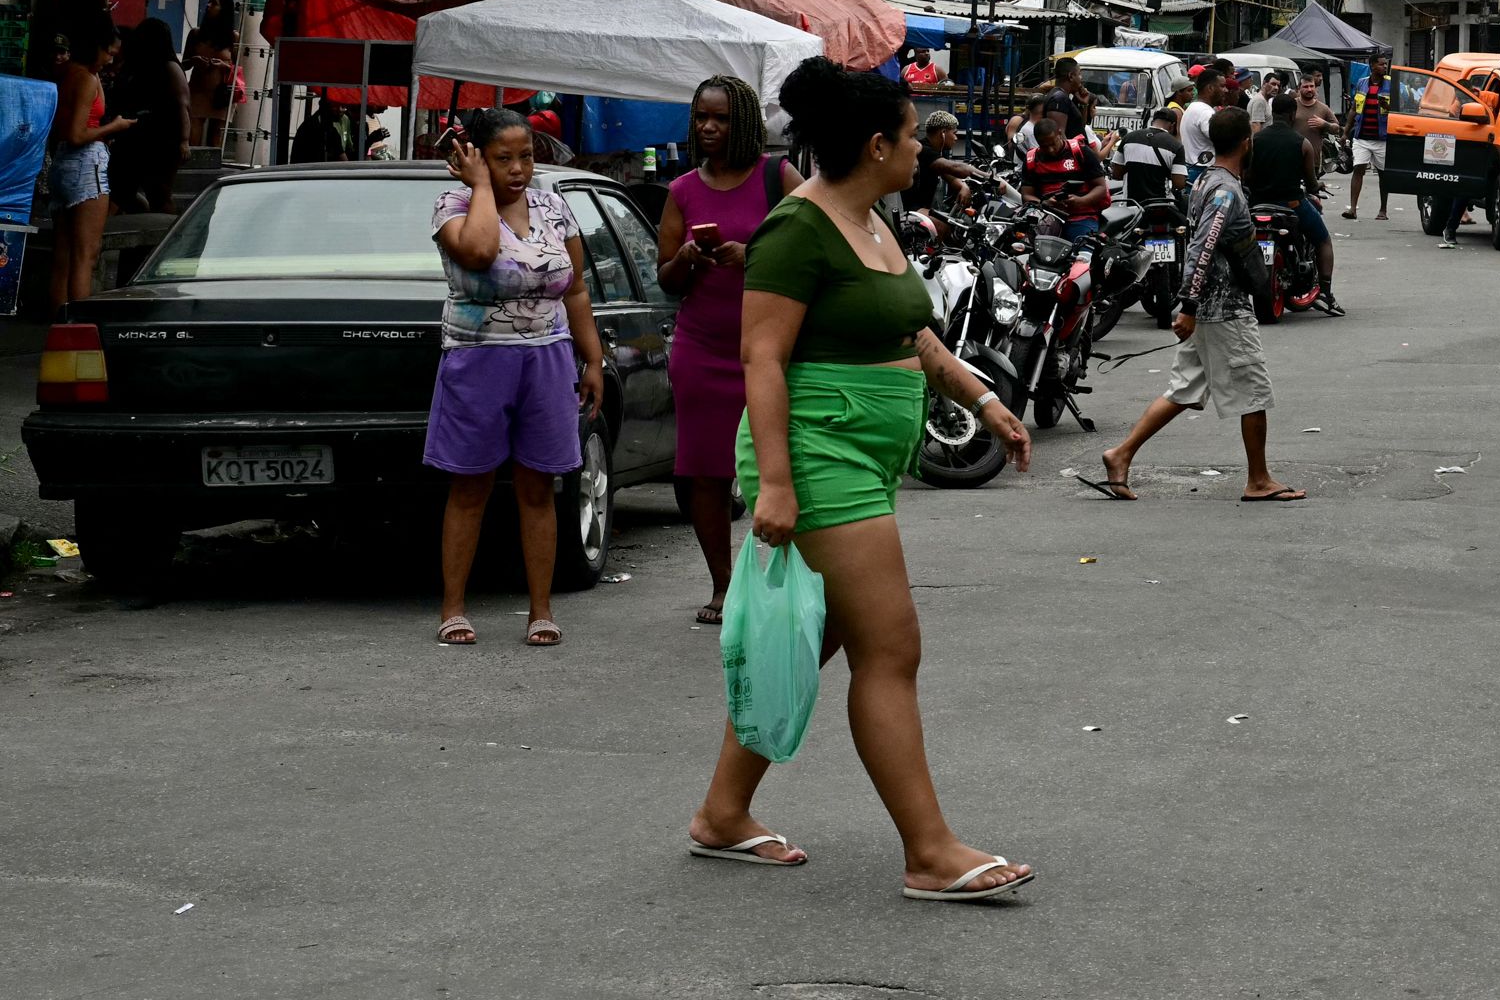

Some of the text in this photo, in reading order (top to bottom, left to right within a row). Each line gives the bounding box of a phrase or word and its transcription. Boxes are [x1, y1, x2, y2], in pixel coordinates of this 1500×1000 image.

[1093, 115, 1144, 130] DALCY FRETE
[1416, 171, 1459, 182] ARDC-032
[1205, 210, 1226, 254] AMIGOS
[1155, 252, 1171, 260] E04
[1199, 251, 1211, 267] DA
[1189, 265, 1208, 298] PESCA
[118, 331, 194, 339] MONZA GL
[343, 330, 426, 339] CHEVROLET
